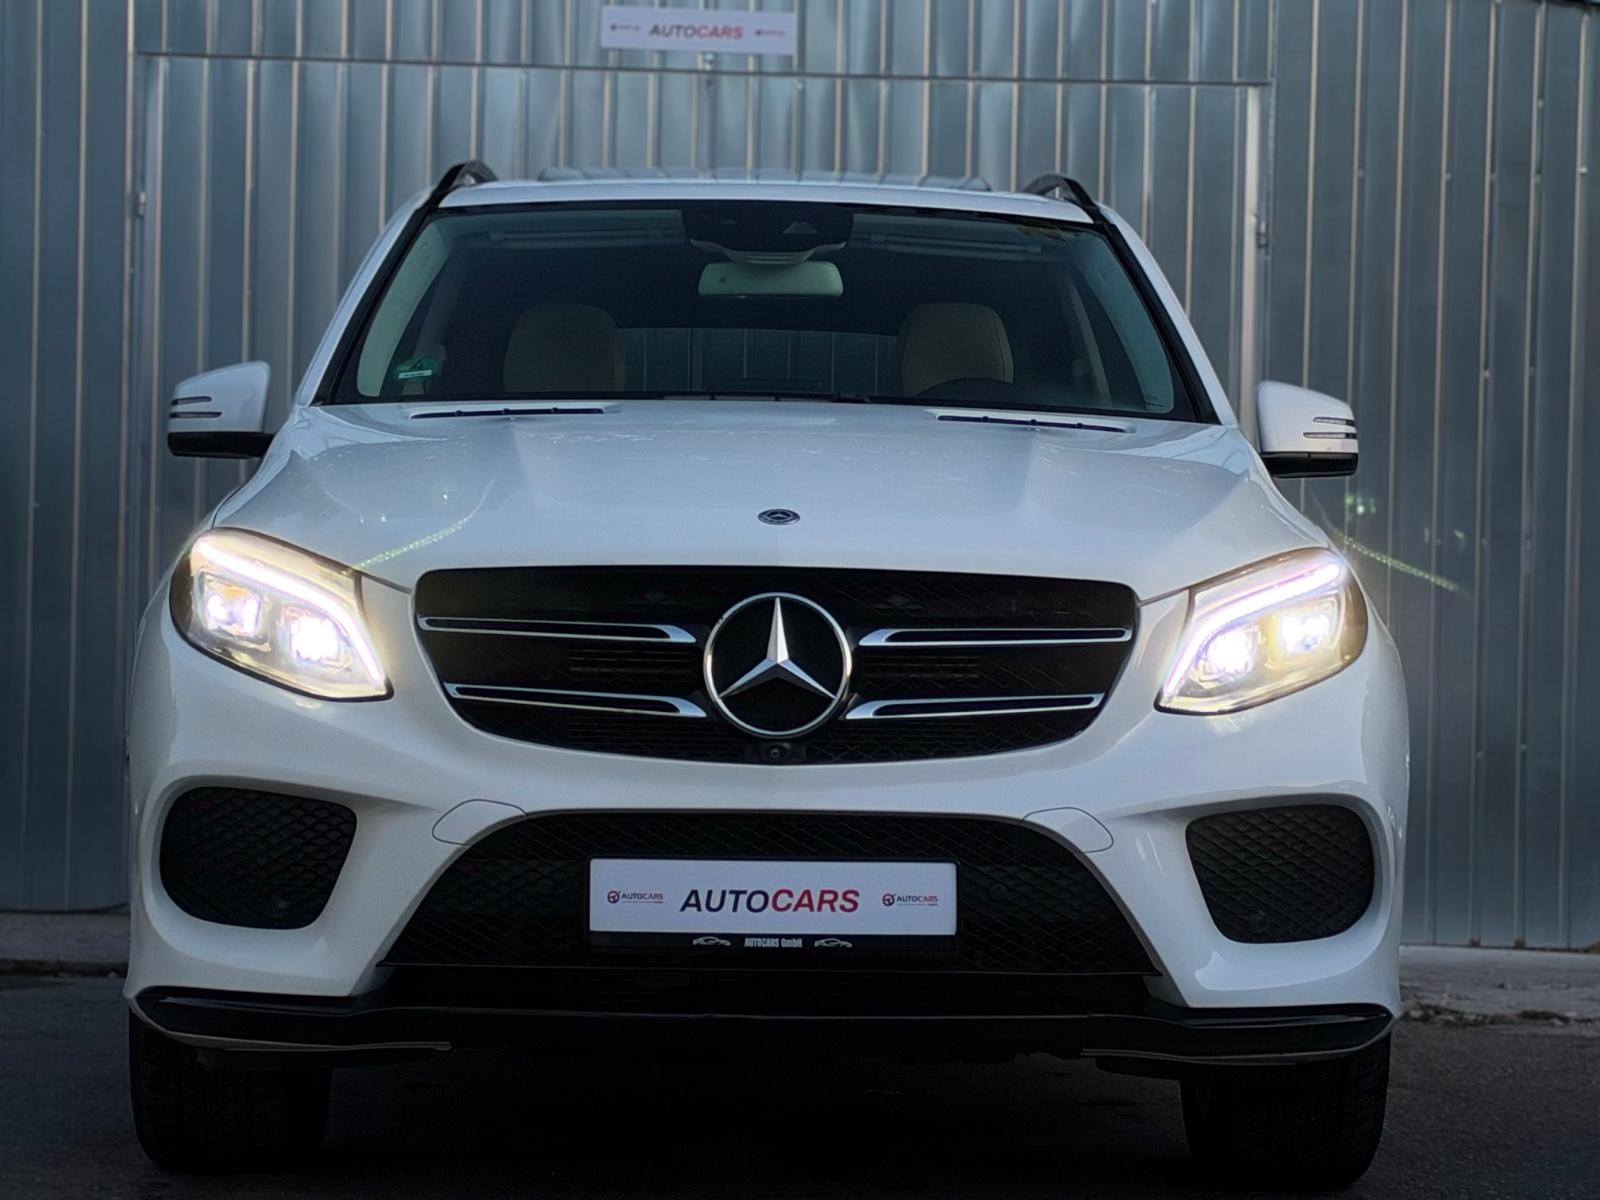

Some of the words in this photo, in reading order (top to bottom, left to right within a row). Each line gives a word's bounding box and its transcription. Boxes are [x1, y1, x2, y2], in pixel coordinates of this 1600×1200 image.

[650, 24, 744, 39] AUTOCARS
[622, 892, 663, 900] AUTOCARS
[680, 889, 860, 913] AUTOCARS
[744, 937, 779, 948] AUTOCARS
